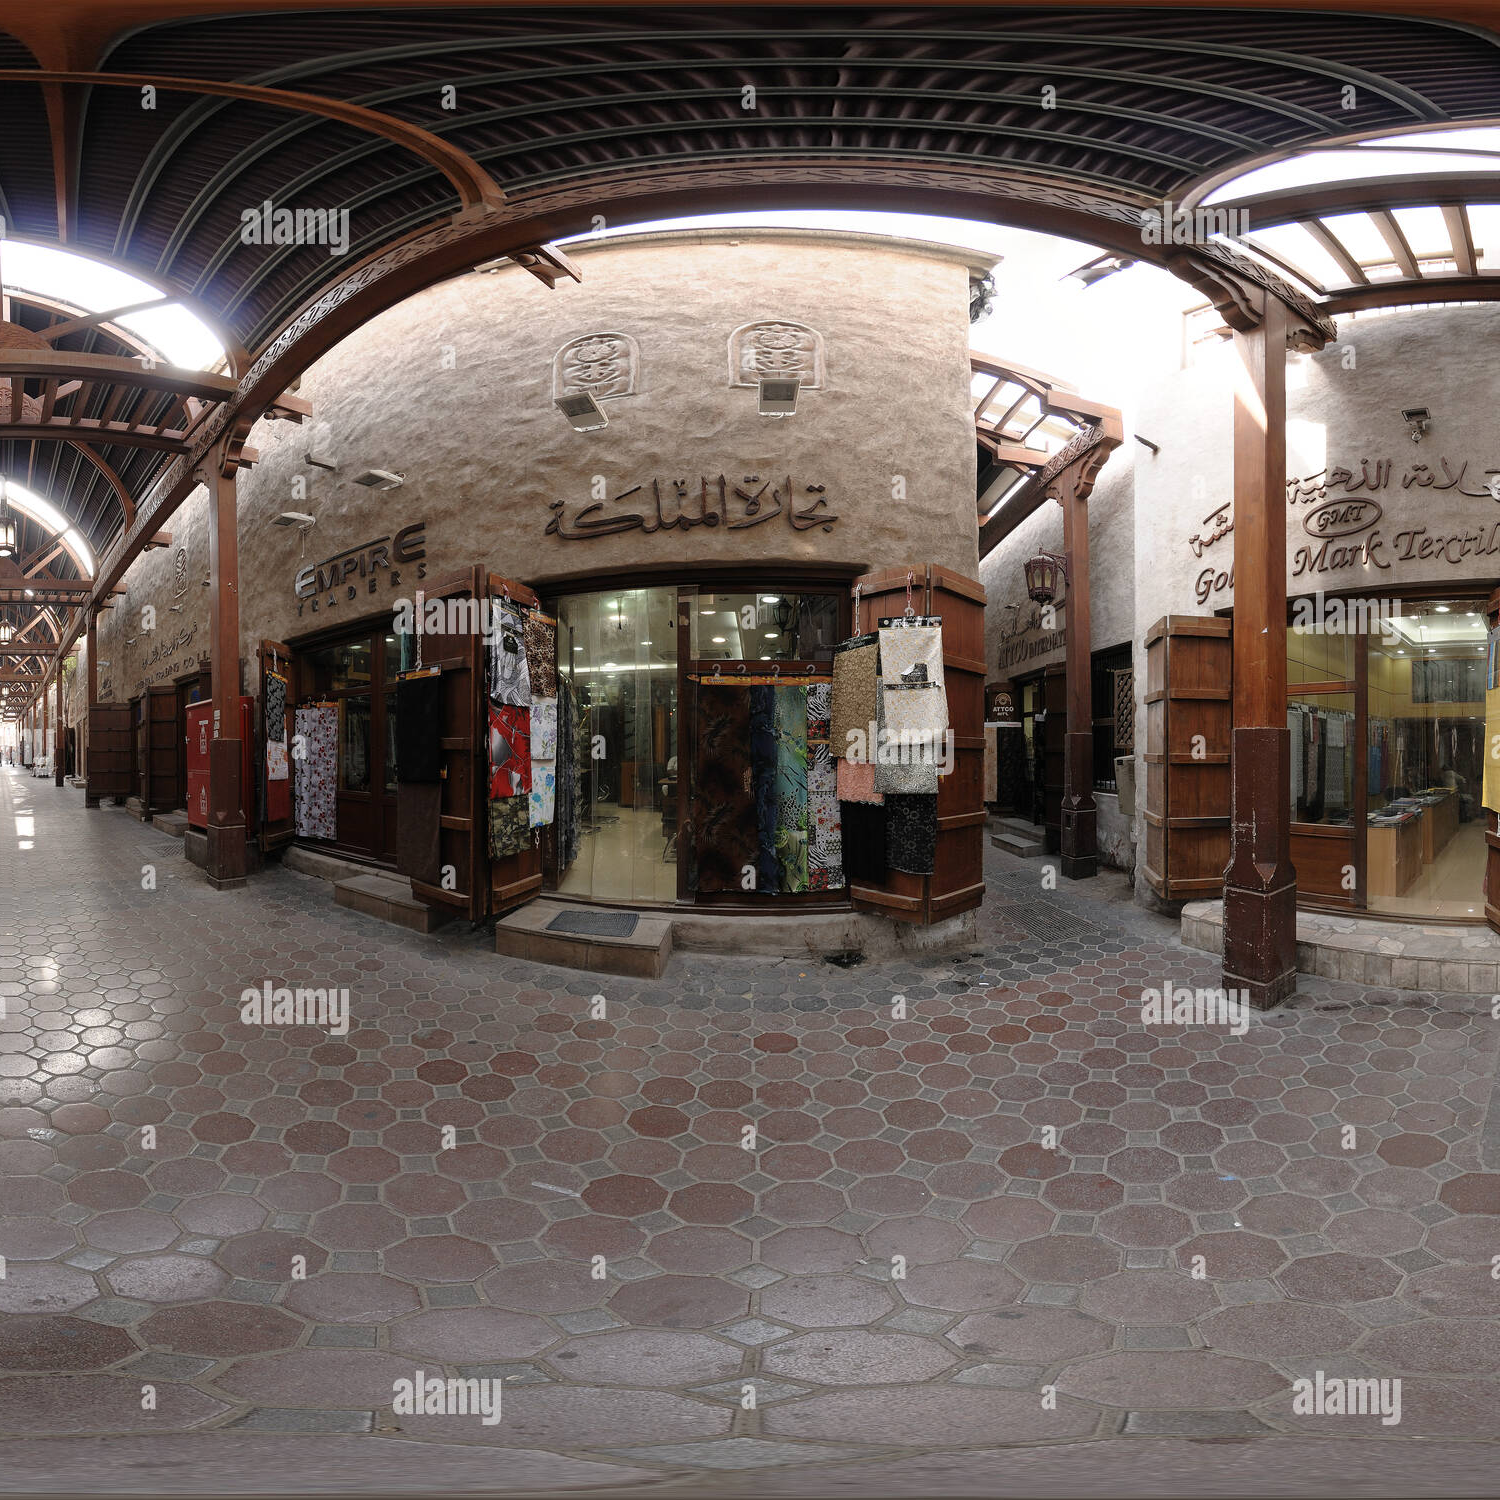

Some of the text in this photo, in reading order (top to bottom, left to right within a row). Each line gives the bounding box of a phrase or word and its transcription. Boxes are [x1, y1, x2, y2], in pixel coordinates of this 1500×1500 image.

[727, 474, 838, 533] تجارة
[1316, 502, 1367, 531] GMT
[294, 522, 426, 599] EMPIRE
[297, 563, 427, 616] TRADERS
[1195, 561, 1235, 605] Gol
[1292, 530, 1391, 577] Mark
